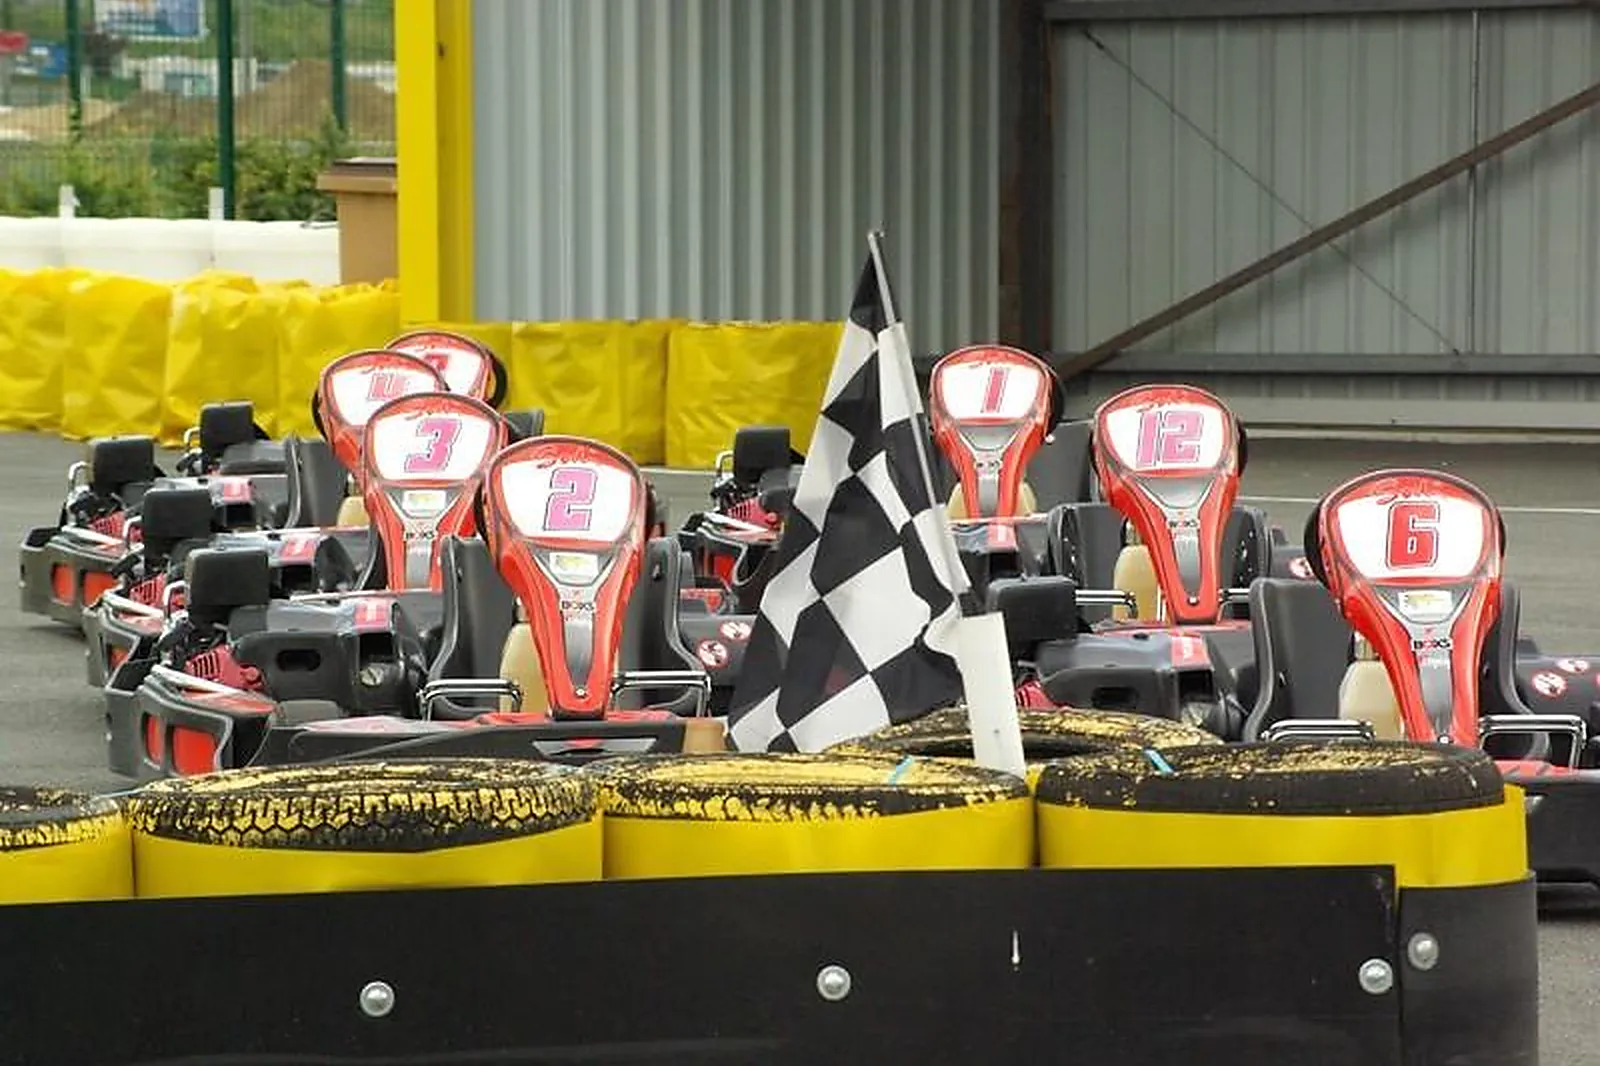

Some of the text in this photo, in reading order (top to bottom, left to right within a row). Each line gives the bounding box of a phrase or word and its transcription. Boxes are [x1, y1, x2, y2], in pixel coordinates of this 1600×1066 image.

[980, 366, 1010, 413] 1
[404, 417, 462, 473] 3
[1136, 410, 1204, 467] 12
[543, 467, 598, 531] 2
[1386, 500, 1440, 569] 6
